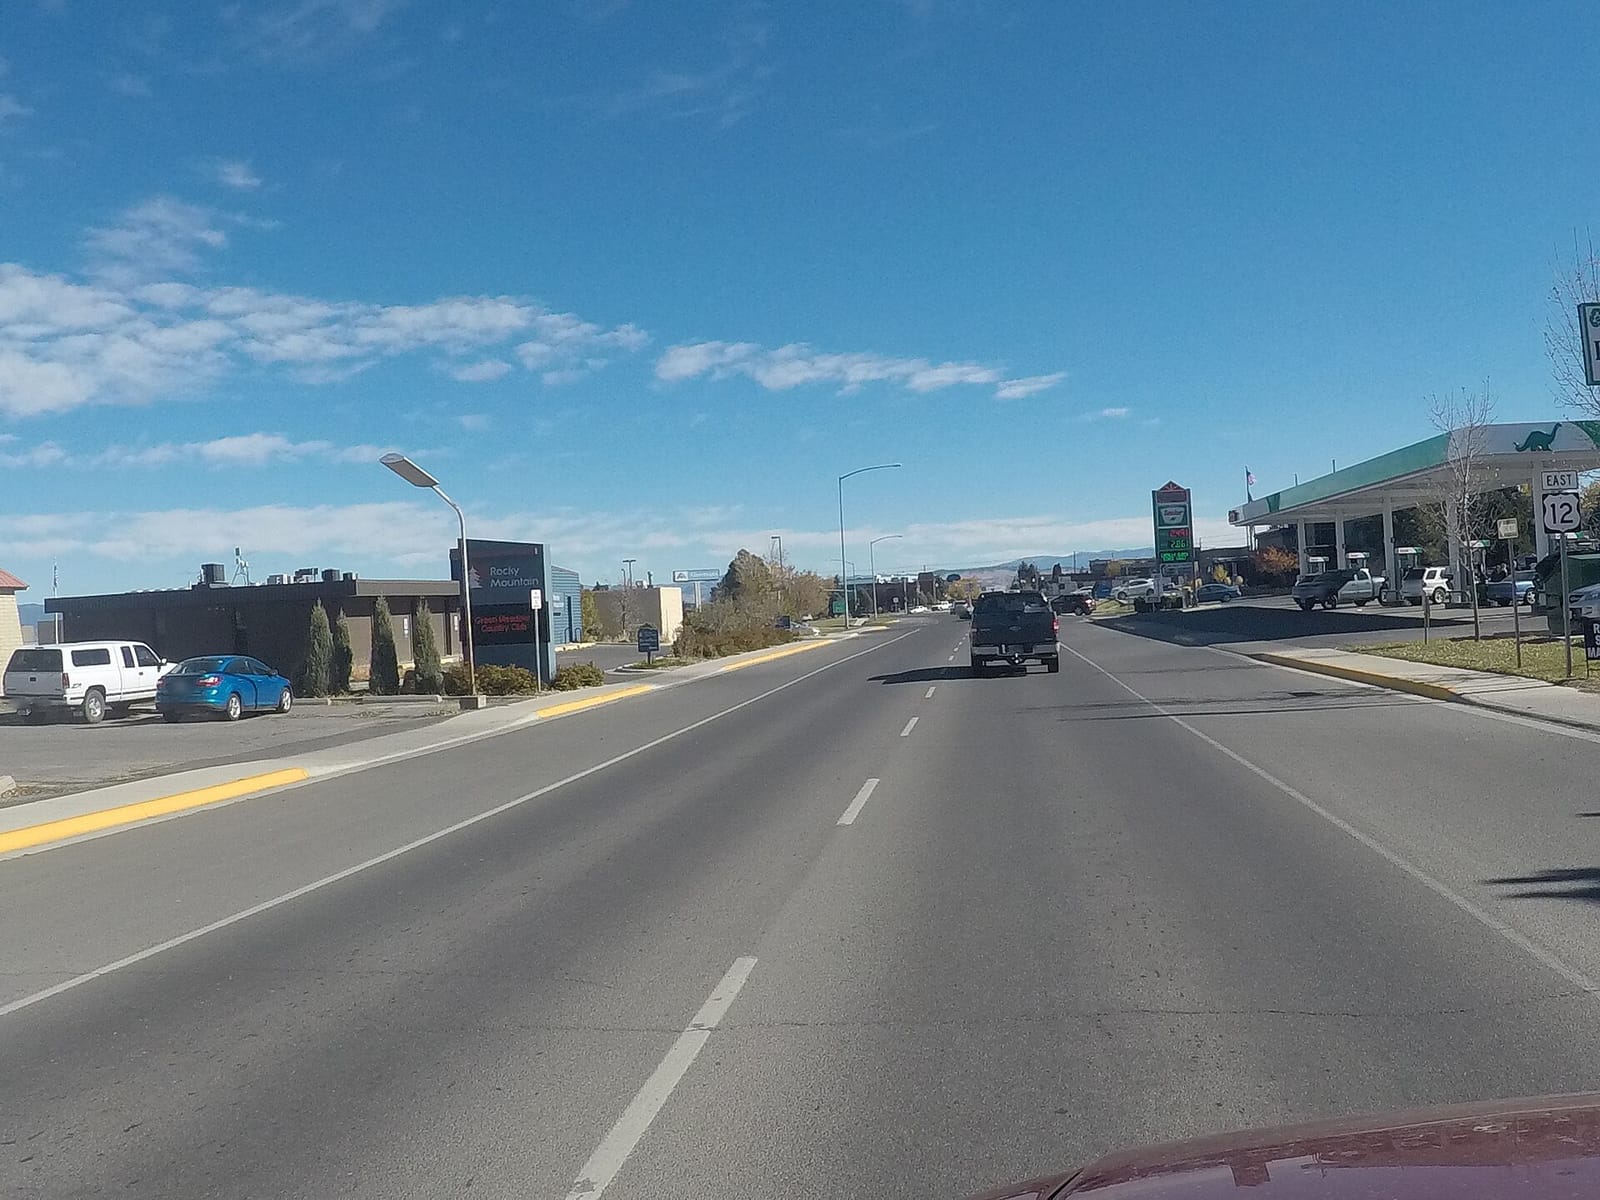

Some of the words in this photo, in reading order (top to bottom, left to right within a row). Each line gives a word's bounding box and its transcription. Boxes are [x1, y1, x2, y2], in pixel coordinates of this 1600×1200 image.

[1546, 474, 1571, 486] EAST
[1550, 503, 1573, 524] 12
[490, 566, 519, 576] Rocky
[490, 577, 539, 588] Mountain
